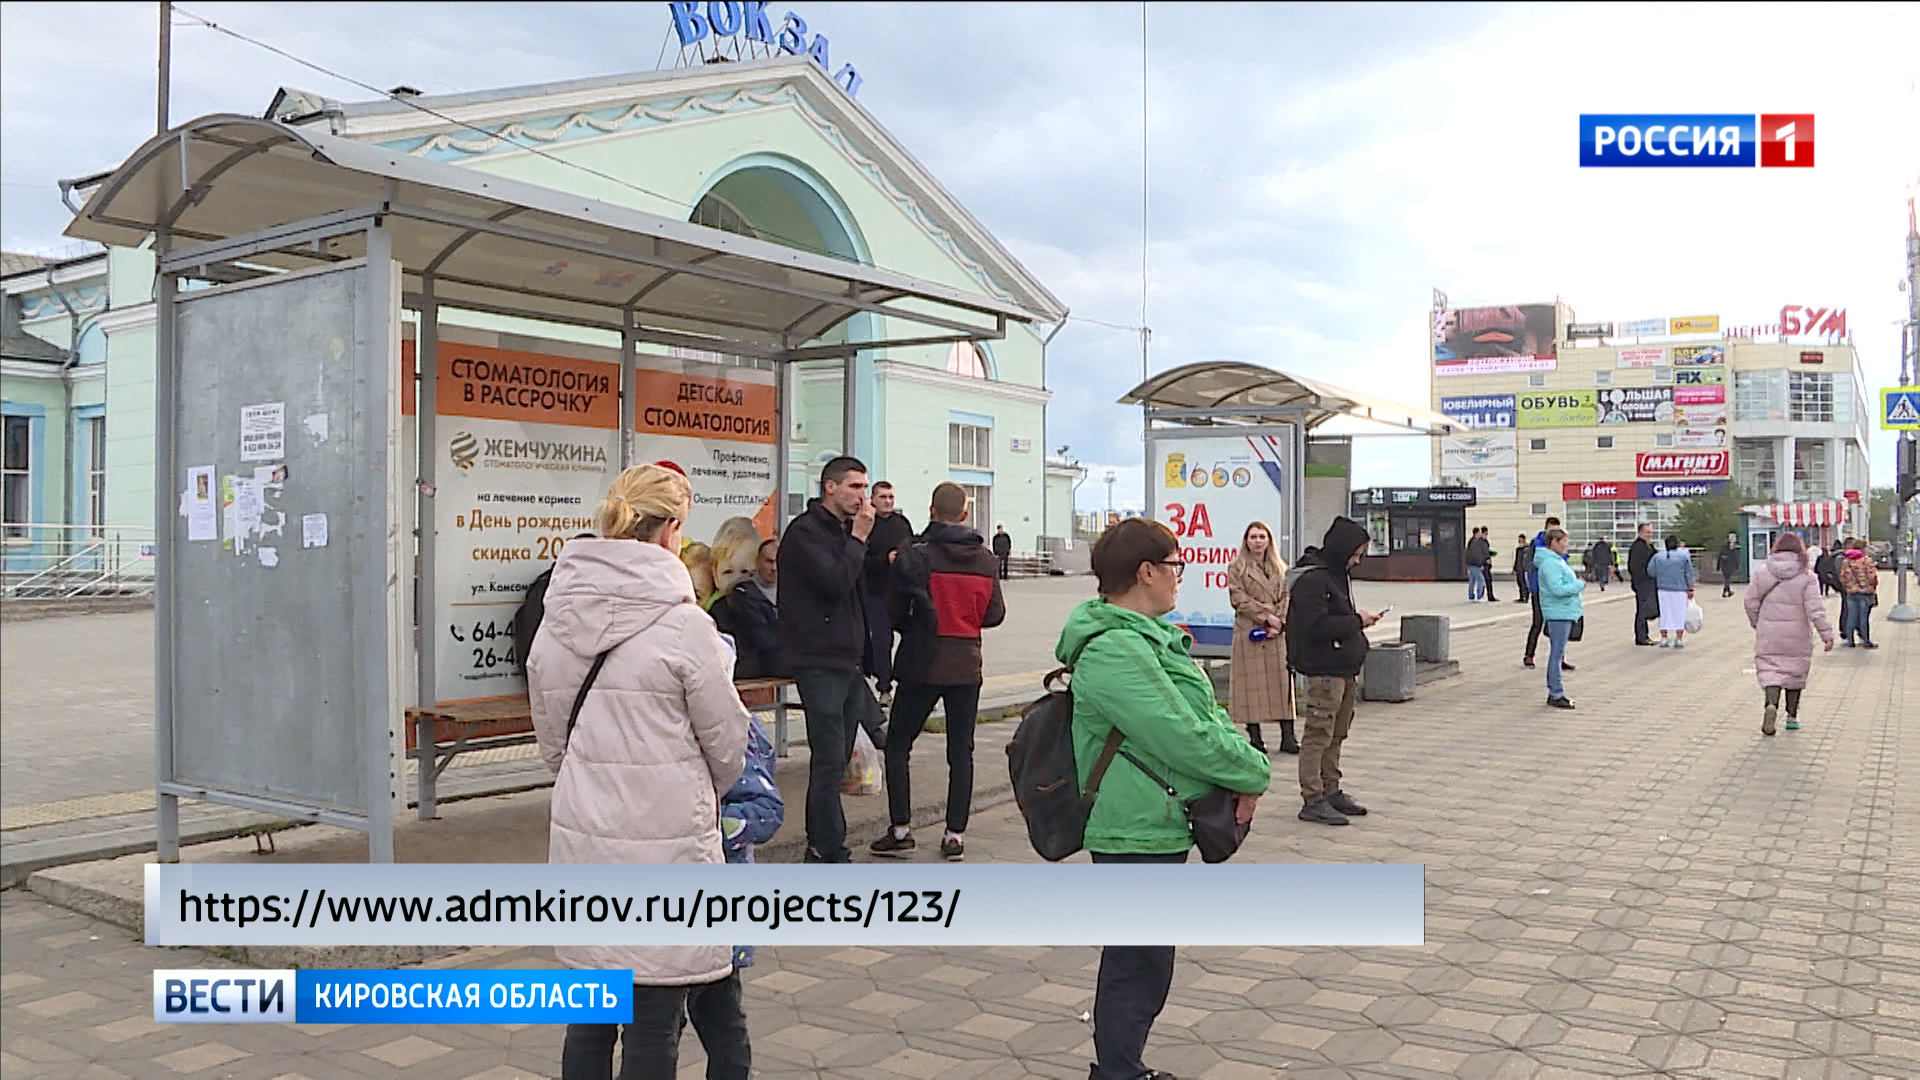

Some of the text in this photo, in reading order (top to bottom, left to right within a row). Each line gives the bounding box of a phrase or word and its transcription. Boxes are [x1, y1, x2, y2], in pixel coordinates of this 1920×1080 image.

[668, 1, 864, 99] ВОКЗАЛ
[1780, 304, 1846, 338] БУМ
[451, 358, 609, 394] СТОМАТОЛОГИЯ
[1676, 371, 1702, 384] FIX
[464, 383, 475, 402] В
[677, 382, 743, 406] ДЕТСКАЯ
[1443, 397, 1514, 410] ЮВЕЛИРНЫЙ
[1521, 395, 1580, 410] ОБУВЬ
[644, 407, 771, 436] СТОМАТОЛОГИЯ
[484, 437, 607, 463] ЖЕМЧУЖИНА
[1645, 455, 1720, 470] МАГНИТ
[691, 467, 730, 478] лечение,
[477, 493, 581, 507] на лечение кариеса
[693, 493, 769, 507] Осмотр БЕСПЛАТНО
[1596, 487, 1618, 496] МТС
[456, 515, 465, 528] в
[469, 509, 512, 532] День
[1164, 503, 1213, 538] ЗА
[472, 536, 574, 564] скидка 20
[1178, 547, 1238, 564] ЮБИМ
[1205, 571, 1228, 589] ГО
[471, 585, 487, 596] ул.
[472, 621, 515, 642] 64-4
[473, 648, 516, 669] 26-4
